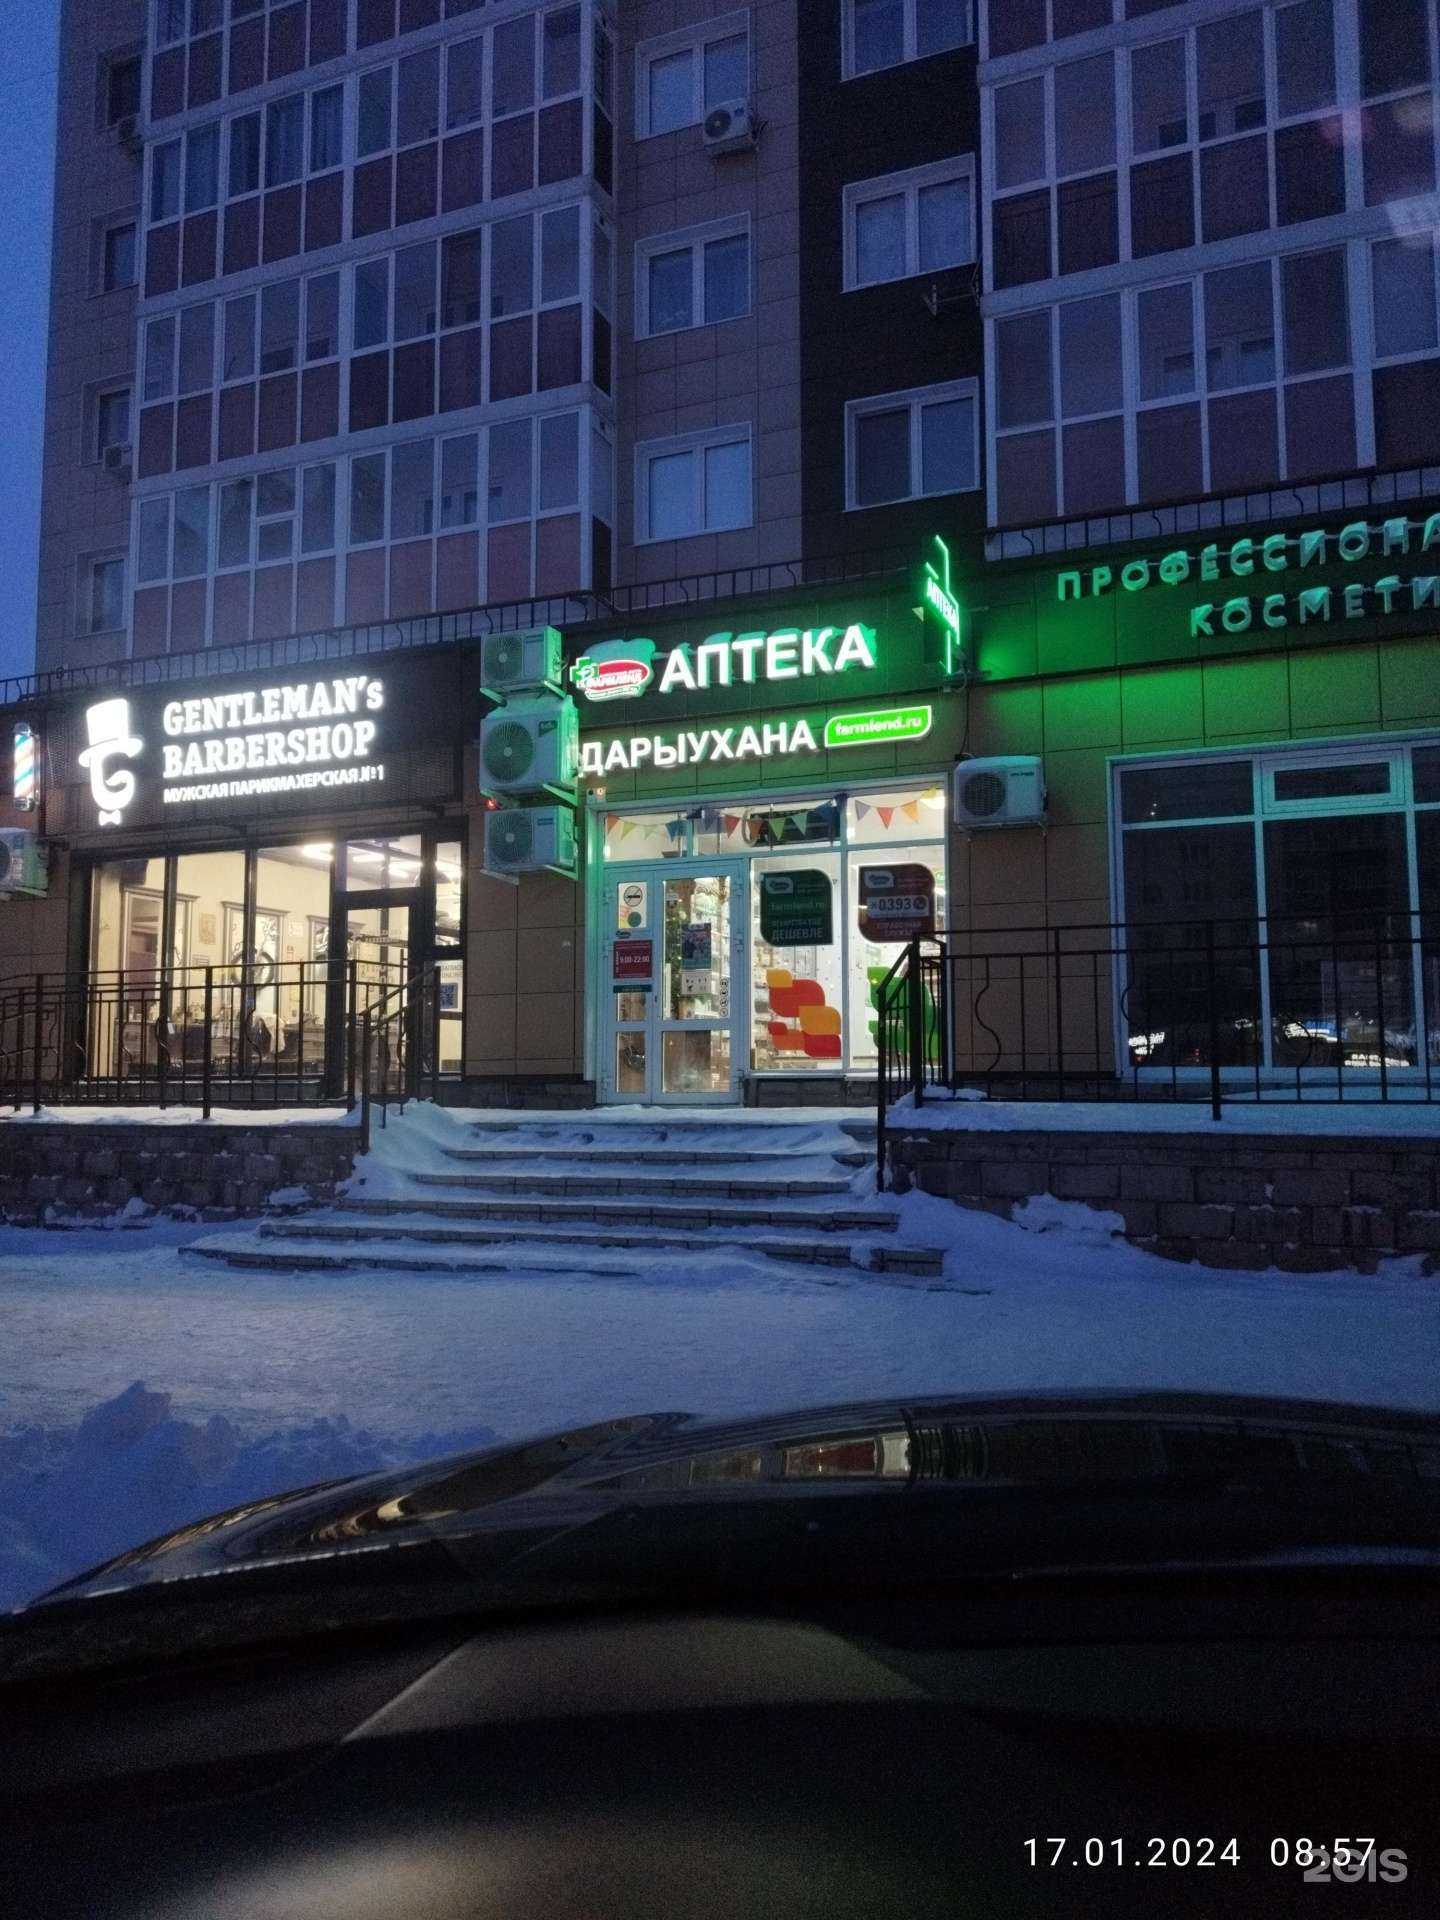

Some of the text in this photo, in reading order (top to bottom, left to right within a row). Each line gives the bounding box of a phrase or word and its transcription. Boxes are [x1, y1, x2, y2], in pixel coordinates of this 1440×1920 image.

[1191, 575, 1440, 637] КОСМЕТИ
[659, 623, 875, 693] АПТЕКА
[163, 721, 375, 778] BARBERSHOP
[581, 720, 817, 776] ДАРЫУХАНА
[835, 715, 922, 736] farmlend.ru
[163, 782, 229, 803] МУЖСКАЯ
[230, 768, 359, 796] ПАРИКМАХЕРСКАЯ
